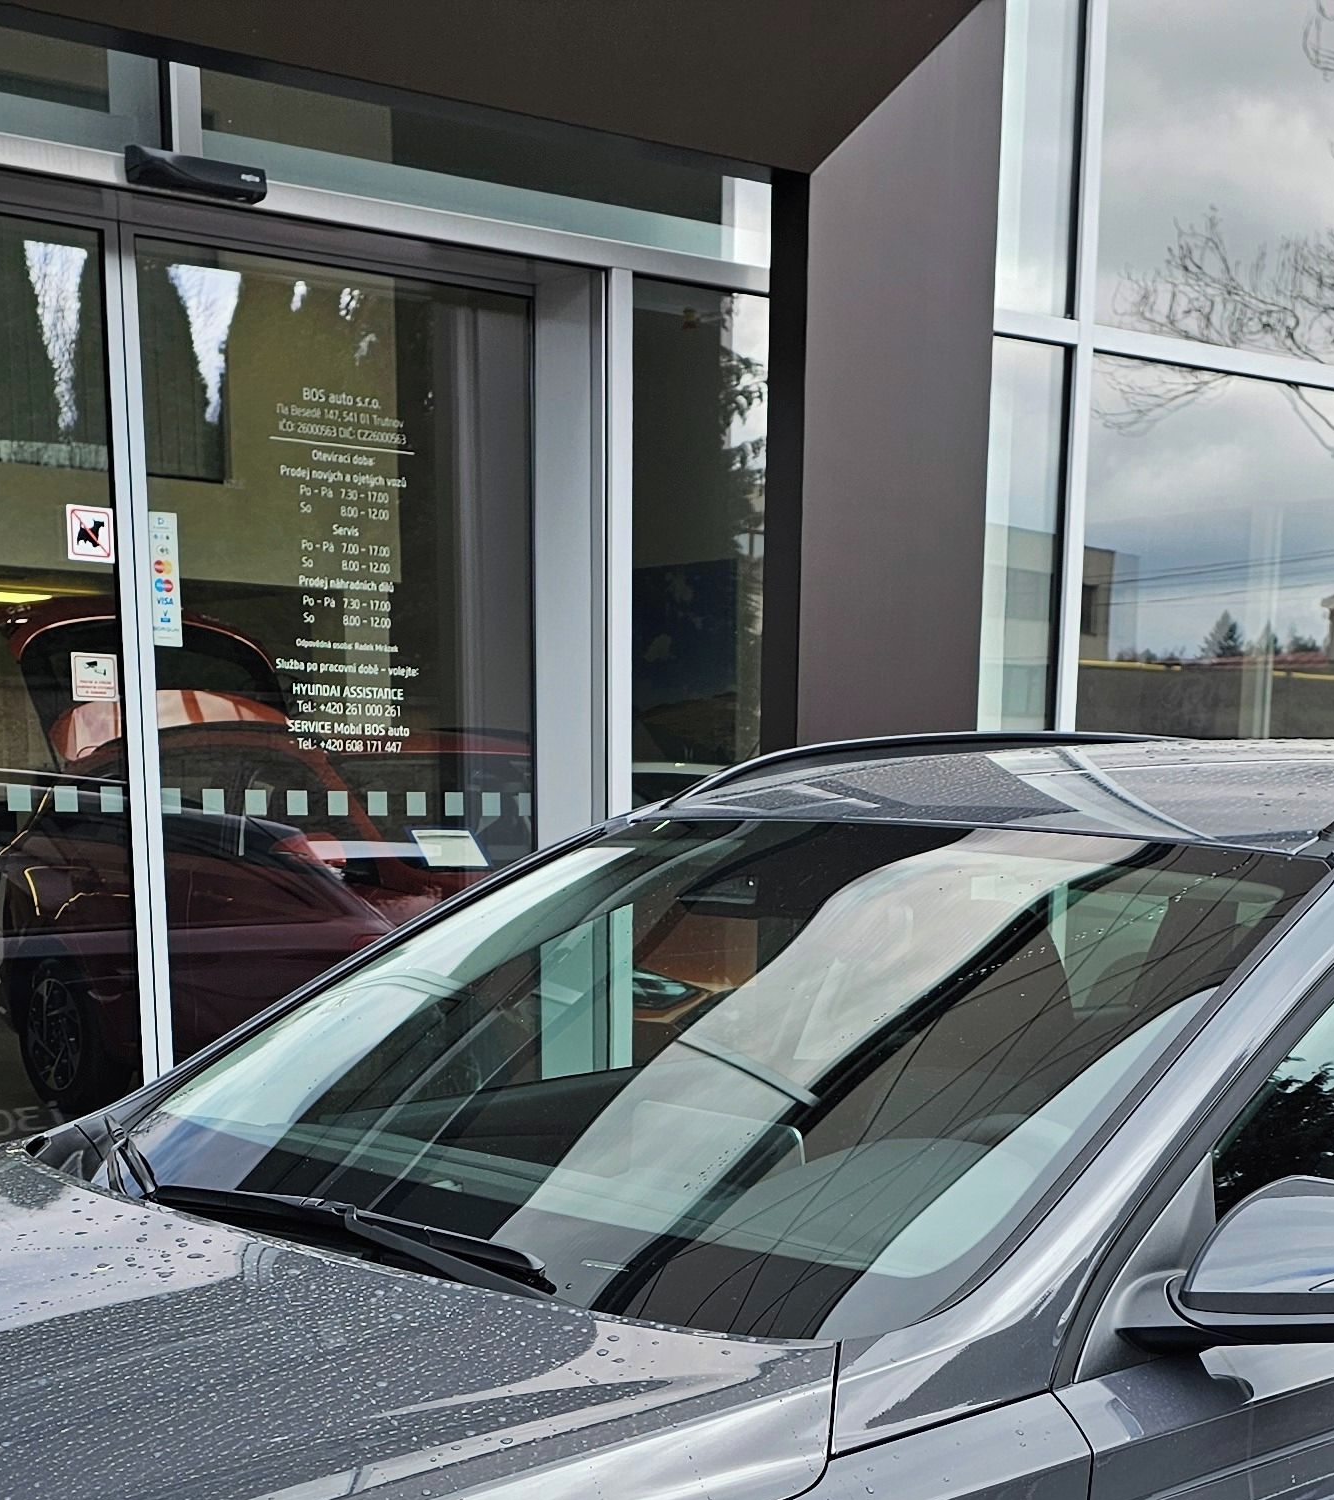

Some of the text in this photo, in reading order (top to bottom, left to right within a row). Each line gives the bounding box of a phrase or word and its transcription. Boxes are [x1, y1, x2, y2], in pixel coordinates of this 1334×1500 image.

[303, 387, 382, 410] BOS auto s.r.o.
[342, 410, 358, 423] 541
[359, 412, 370, 425] 01
[280, 464, 310, 481] Prodej
[312, 469, 344, 483] nových
[345, 473, 352, 483] a
[299, 484, 312, 497] Po
[320, 486, 334, 498] Pá
[340, 488, 358, 501] 7.30
[368, 491, 389, 504] 17.00
[299, 501, 312, 513] So
[340, 505, 359, 518] 8.00
[368, 508, 390, 521] 12.00
[332, 523, 360, 537] Servis
[301, 539, 314, 551] Po
[322, 541, 335, 553] Pá
[341, 542, 360, 555] 7.00
[368, 544, 391, 558] 17.00
[301, 556, 314, 568] So
[341, 559, 360, 572] 8.00
[369, 561, 391, 574] 12.00
[298, 574, 328, 590] Prodej
[157, 596, 174, 606] VISA
[302, 594, 315, 607] Po
[323, 596, 336, 608] Pá
[342, 597, 361, 610] 7.30
[369, 599, 392, 613] 17.00
[302, 611, 316, 624] So
[342, 614, 362, 627] 8.00
[370, 616, 392, 629] 12.00
[275, 656, 306, 672] Služba
[306, 661, 319, 673] po
[319, 661, 357, 674] pracovní
[357, 663, 380, 676] době
[388, 665, 420, 679] volejte:
[292, 682, 405, 701] HYUNDAI ASSISTANCE
[296, 699, 402, 718] Tel.: +420 261 000 261
[287, 719, 411, 738] SERVICE Mobil BOS auto
[296, 736, 317, 751] Tel.:
[319, 738, 344, 752] +420
[366, 740, 383, 753] 171
[384, 741, 403, 754] 447
